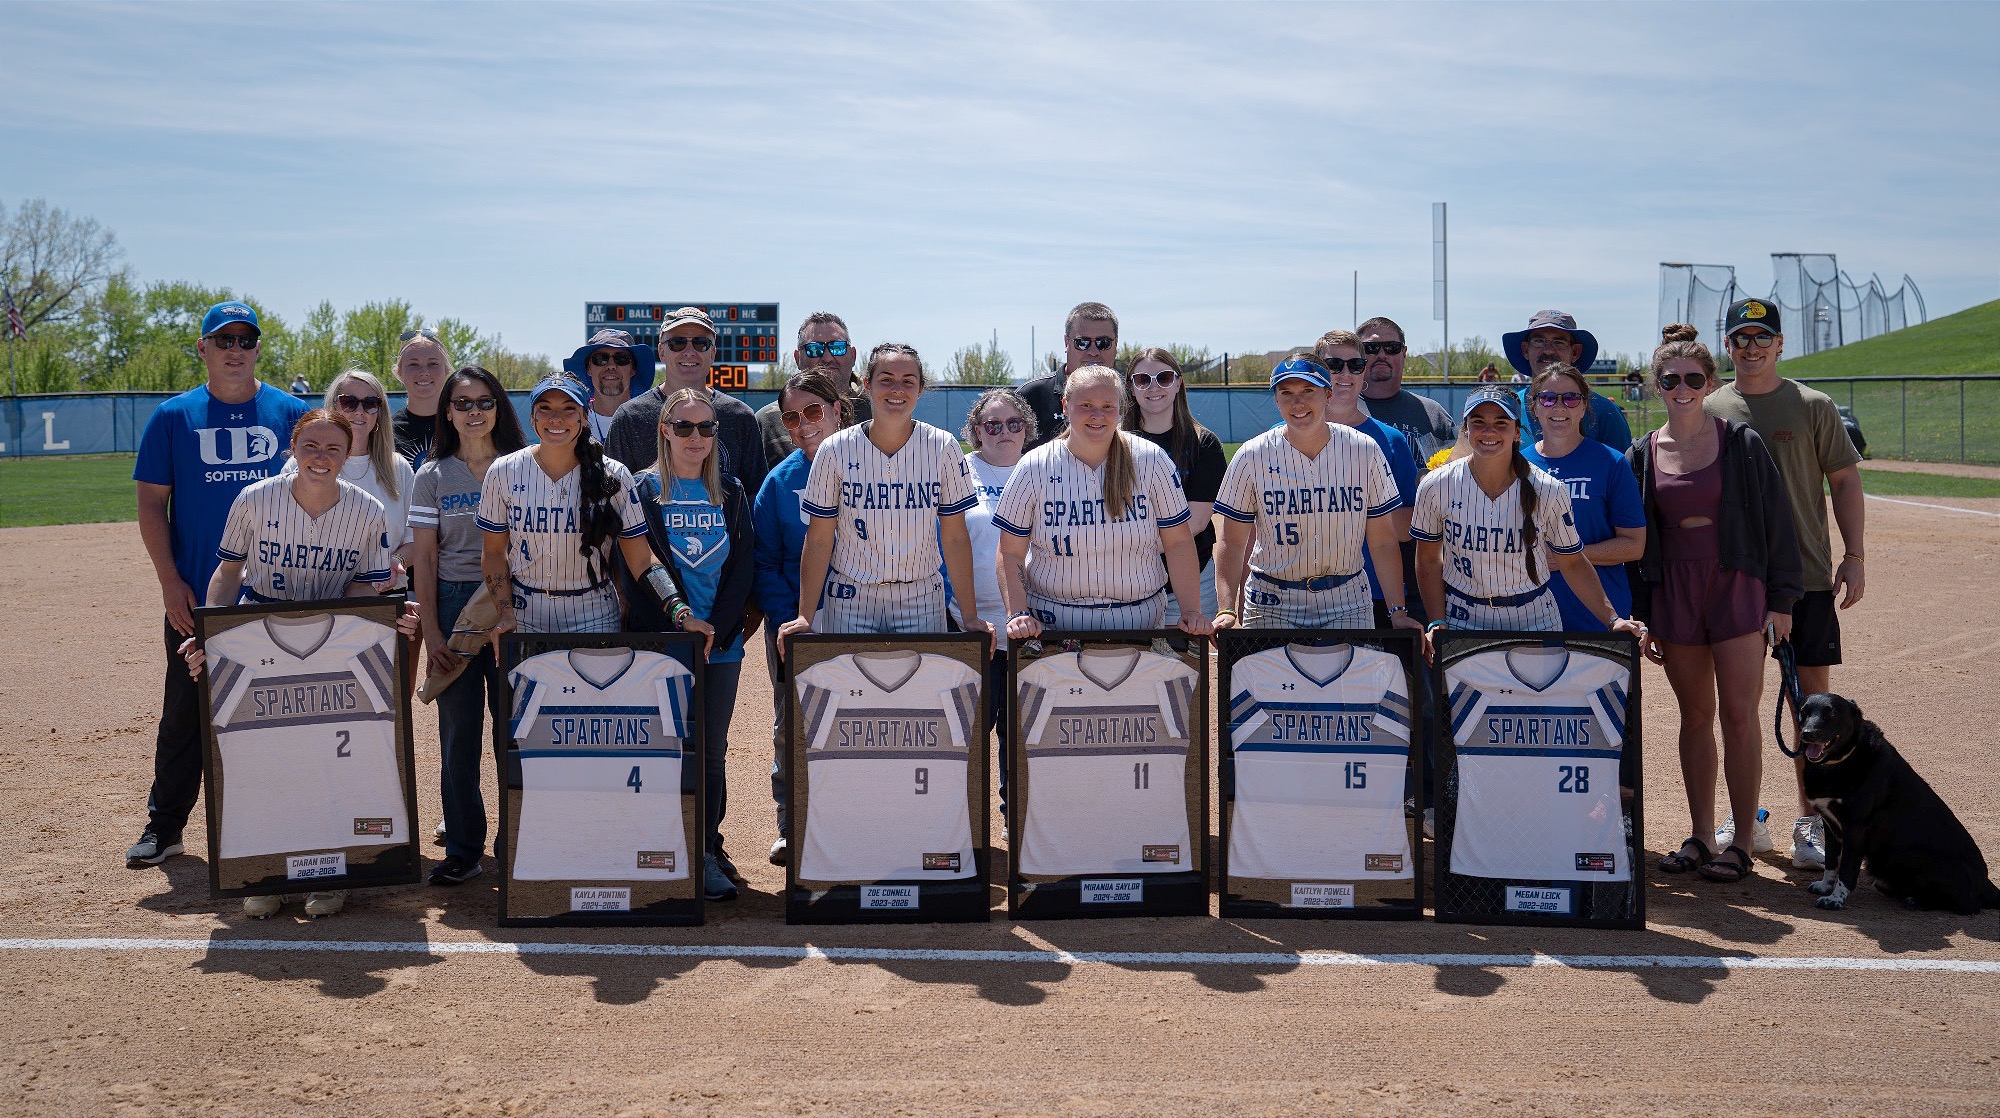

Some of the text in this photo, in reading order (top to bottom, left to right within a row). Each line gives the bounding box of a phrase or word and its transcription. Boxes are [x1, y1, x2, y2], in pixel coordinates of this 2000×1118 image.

[589, 313, 605, 322] BAT
[592, 305, 602, 313] AT
[617, 307, 624, 321] 0
[629, 309, 651, 318] BALL
[654, 307, 661, 320] 0
[710, 309, 727, 318] OUT
[729, 307, 737, 321] 0
[742, 309, 757, 318] H/E
[742, 336, 776, 347] 0 0 0
[742, 350, 776, 361] 0 0 0
[842, 481, 941, 510] SPARTANS
[1263, 486, 1364, 516] SPARTANS
[1043, 494, 1147, 527] SPARTNS
[854, 518, 868, 541] 9
[1274, 522, 1300, 546] 15
[520, 539, 532, 561] 4
[1051, 534, 1074, 557] 11
[258, 540, 360, 572] SPARTANS
[272, 572, 286, 591] 2
[252, 681, 357, 718] SPARTANS
[550, 718, 650, 746] SPARTANS
[838, 720, 938, 748] SPARTANS
[1059, 716, 1157, 746] SPARTANS
[1271, 713, 1372, 742] SPARTANS
[1488, 717, 1590, 746] SPARTANS
[335, 729, 352, 758] 2
[626, 766, 642, 793] 4
[914, 767, 929, 795] 9
[1133, 763, 1149, 790] 11
[1344, 762, 1367, 789] 15
[1558, 766, 1589, 793] 28
[292, 856, 340, 867] CIARAN RIGBY
[297, 867, 337, 877] 2022-2026
[574, 890, 627, 899] KAYLA PONTING
[867, 888, 911, 896] ZOE CONNELL
[1083, 882, 1140, 891] MIRANDA SAYLOR
[1294, 887, 1351, 896] KAITLYN POWELL
[1514, 890, 1561, 900] MEGAN LEICK
[580, 901, 620, 909] 2024-2026
[1093, 893, 1131, 901] 2024-2026
[1517, 901, 1558, 910] 2022-2026
